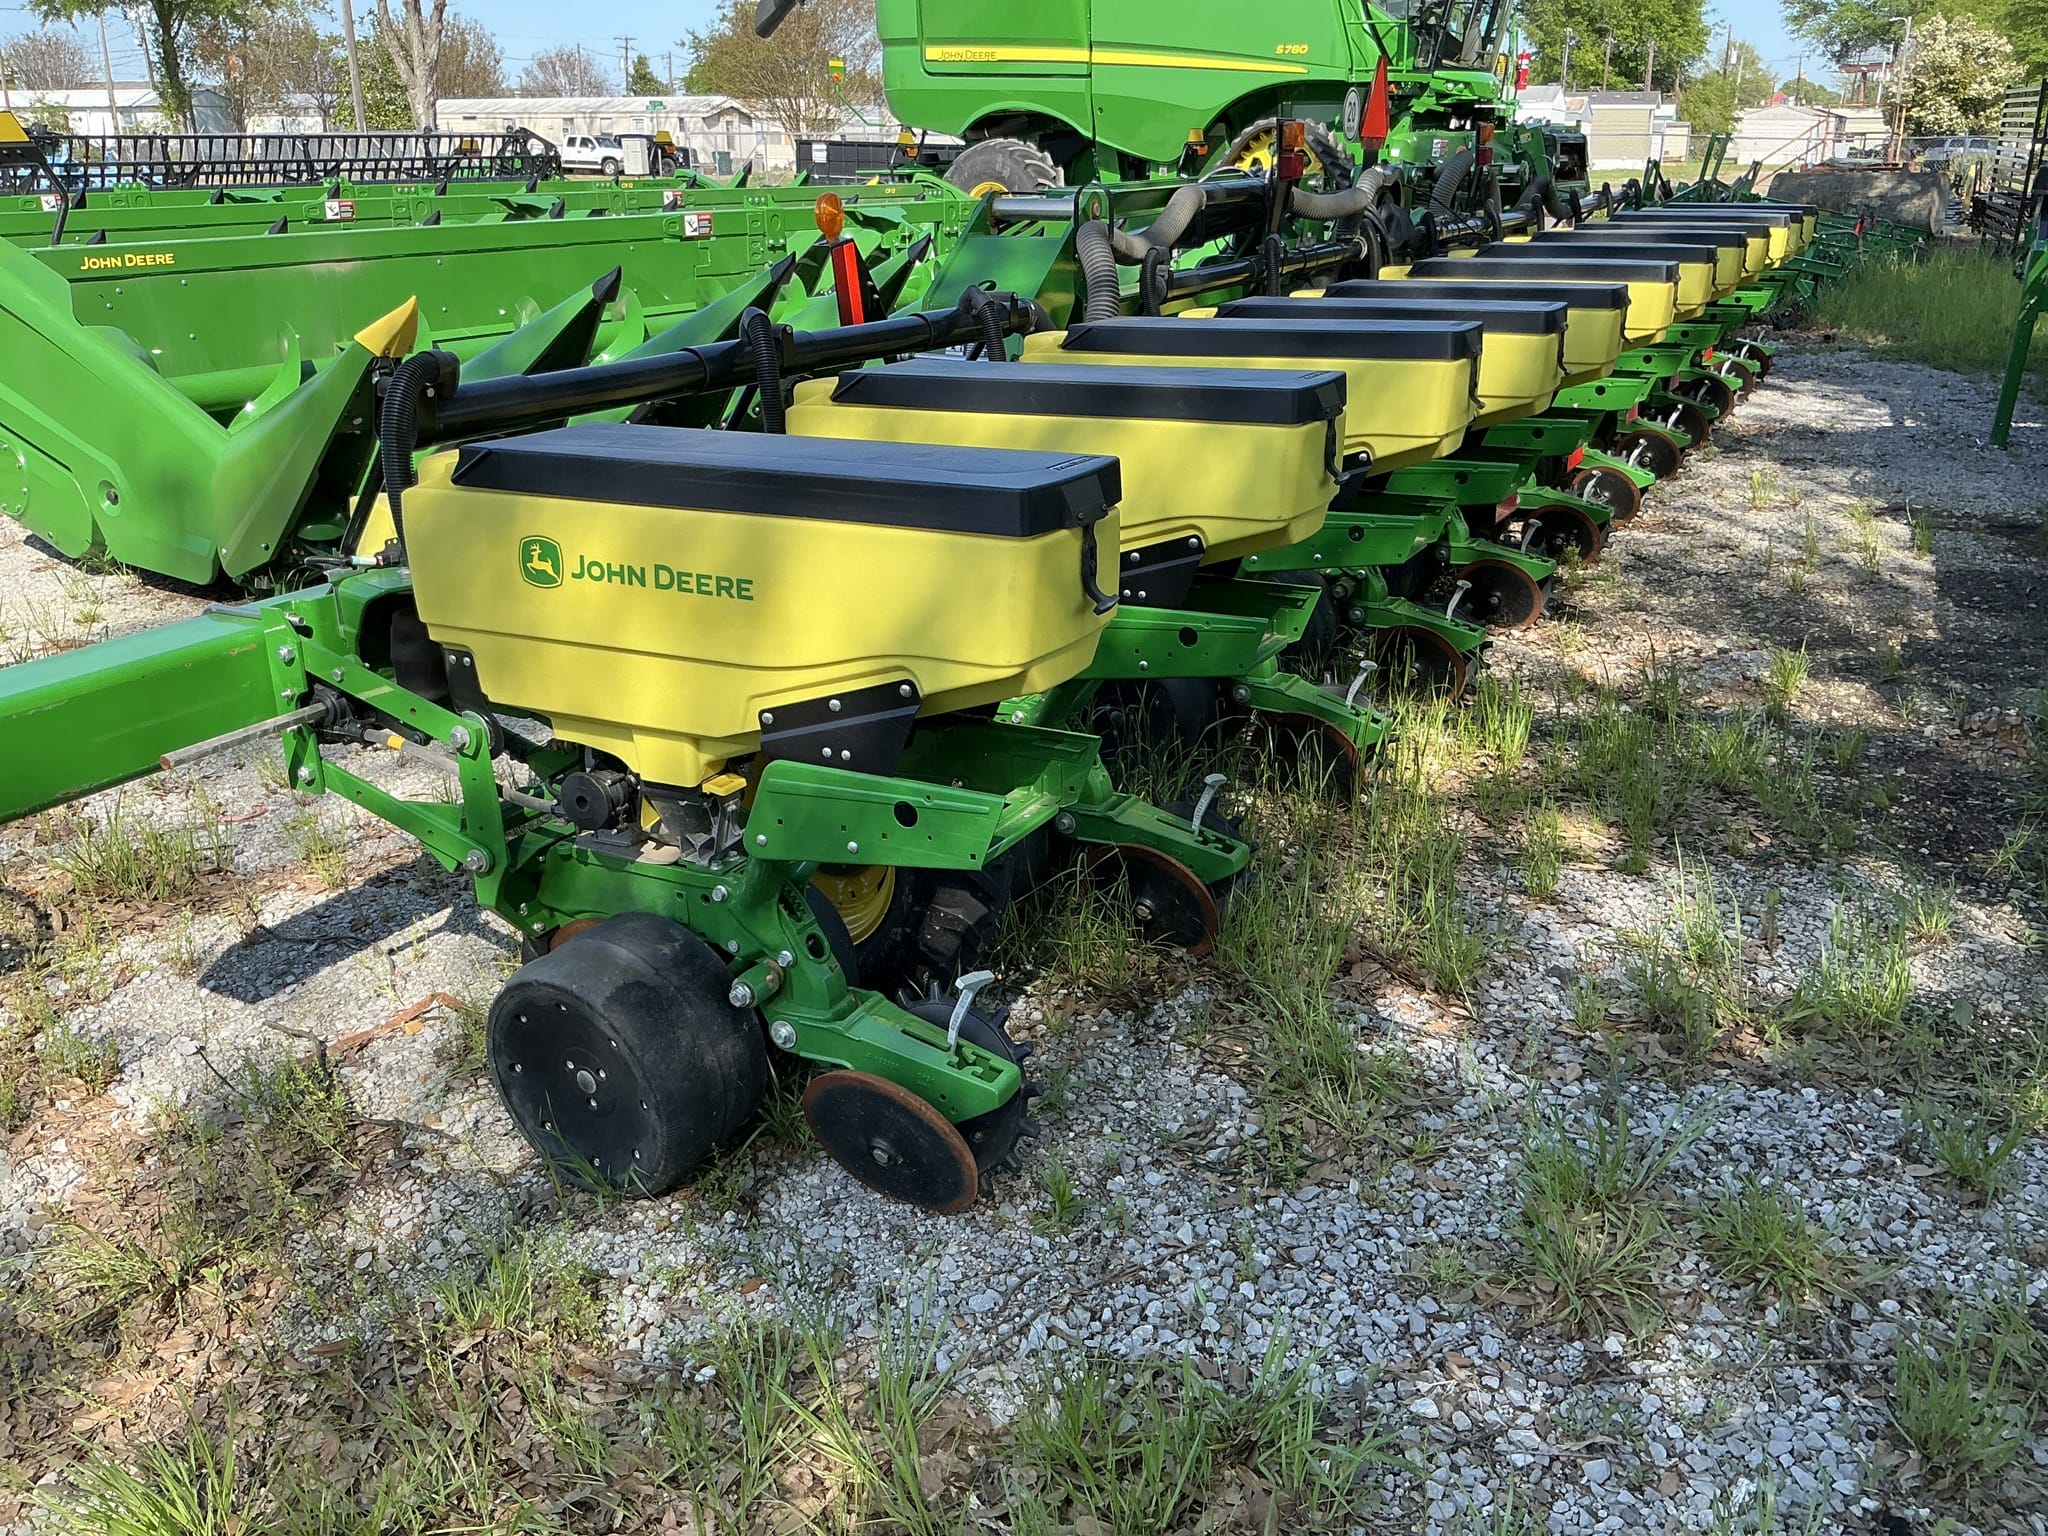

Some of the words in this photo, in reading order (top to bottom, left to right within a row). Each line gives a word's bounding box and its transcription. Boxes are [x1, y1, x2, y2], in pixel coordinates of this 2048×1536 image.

[938, 49, 963, 60] JOHN
[965, 49, 997, 60] DEERE
[1275, 44, 1309, 55] S780
[1347, 101, 1356, 123] 20
[80, 256, 122, 270] JOHN
[124, 253, 175, 267] DEERE
[571, 554, 646, 588] JOHN
[654, 563, 754, 601] DEERE
